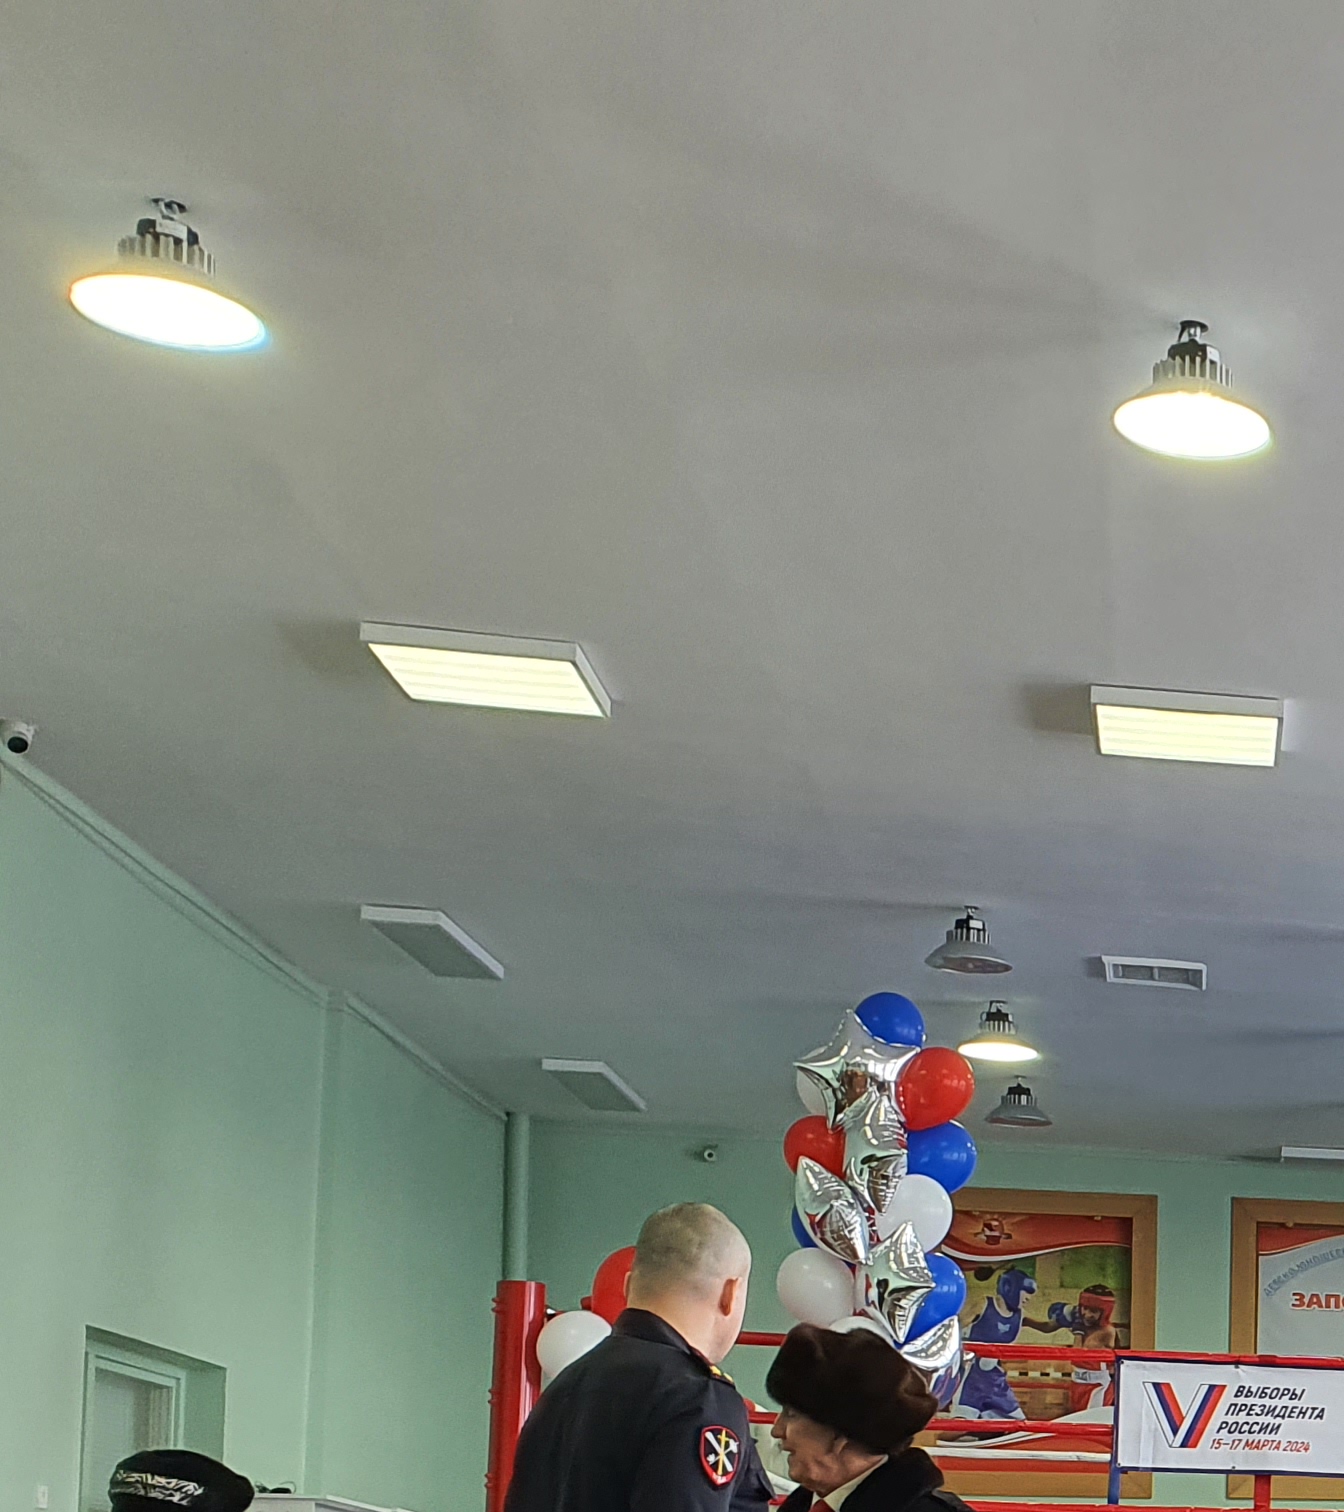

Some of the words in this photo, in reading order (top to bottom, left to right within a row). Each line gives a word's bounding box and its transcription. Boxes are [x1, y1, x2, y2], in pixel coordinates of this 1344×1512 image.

[1233, 1385, 1306, 1401] ВЫБОРЫ
[1224, 1403, 1326, 1420] ПРЕЗИДЕНТА
[1216, 1421, 1282, 1436] РОССИИ
[1242, 1439, 1282, 1451] МАРТА
[1282, 1440, 1311, 1453] 2024
